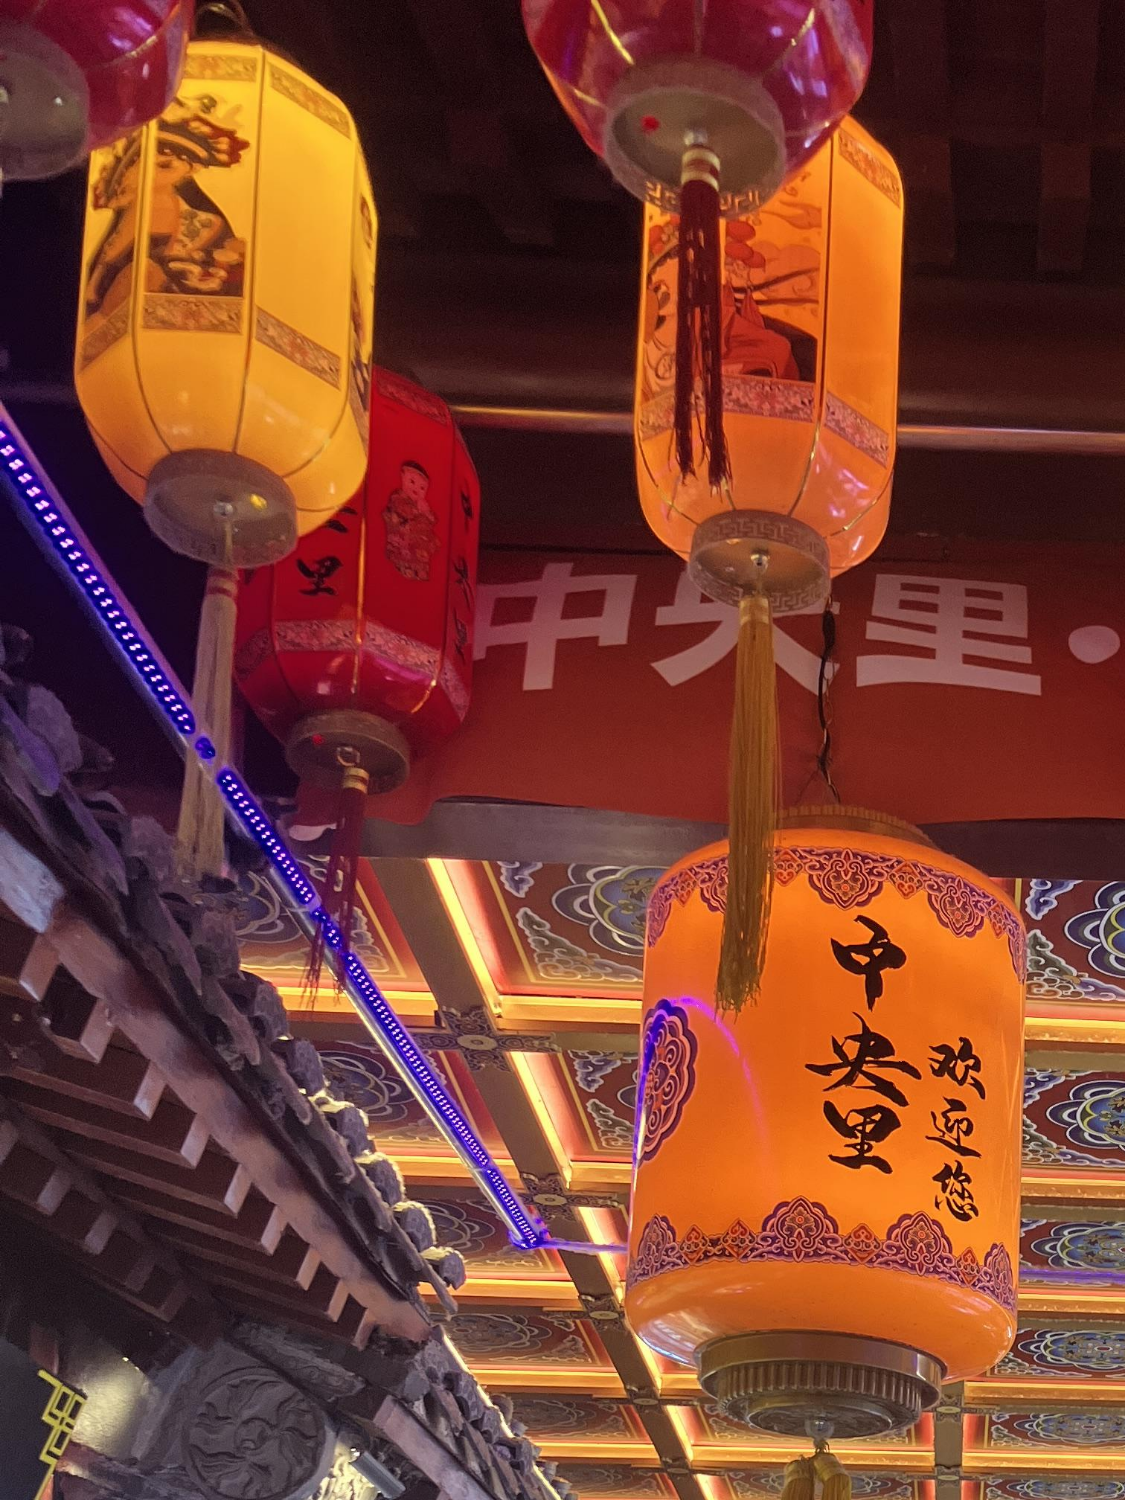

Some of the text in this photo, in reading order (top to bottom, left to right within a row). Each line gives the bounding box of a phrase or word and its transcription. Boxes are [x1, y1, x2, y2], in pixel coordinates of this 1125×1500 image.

[806, 914, 922, 1174] 中央里
[925, 1035, 987, 1222] 欢迎您
